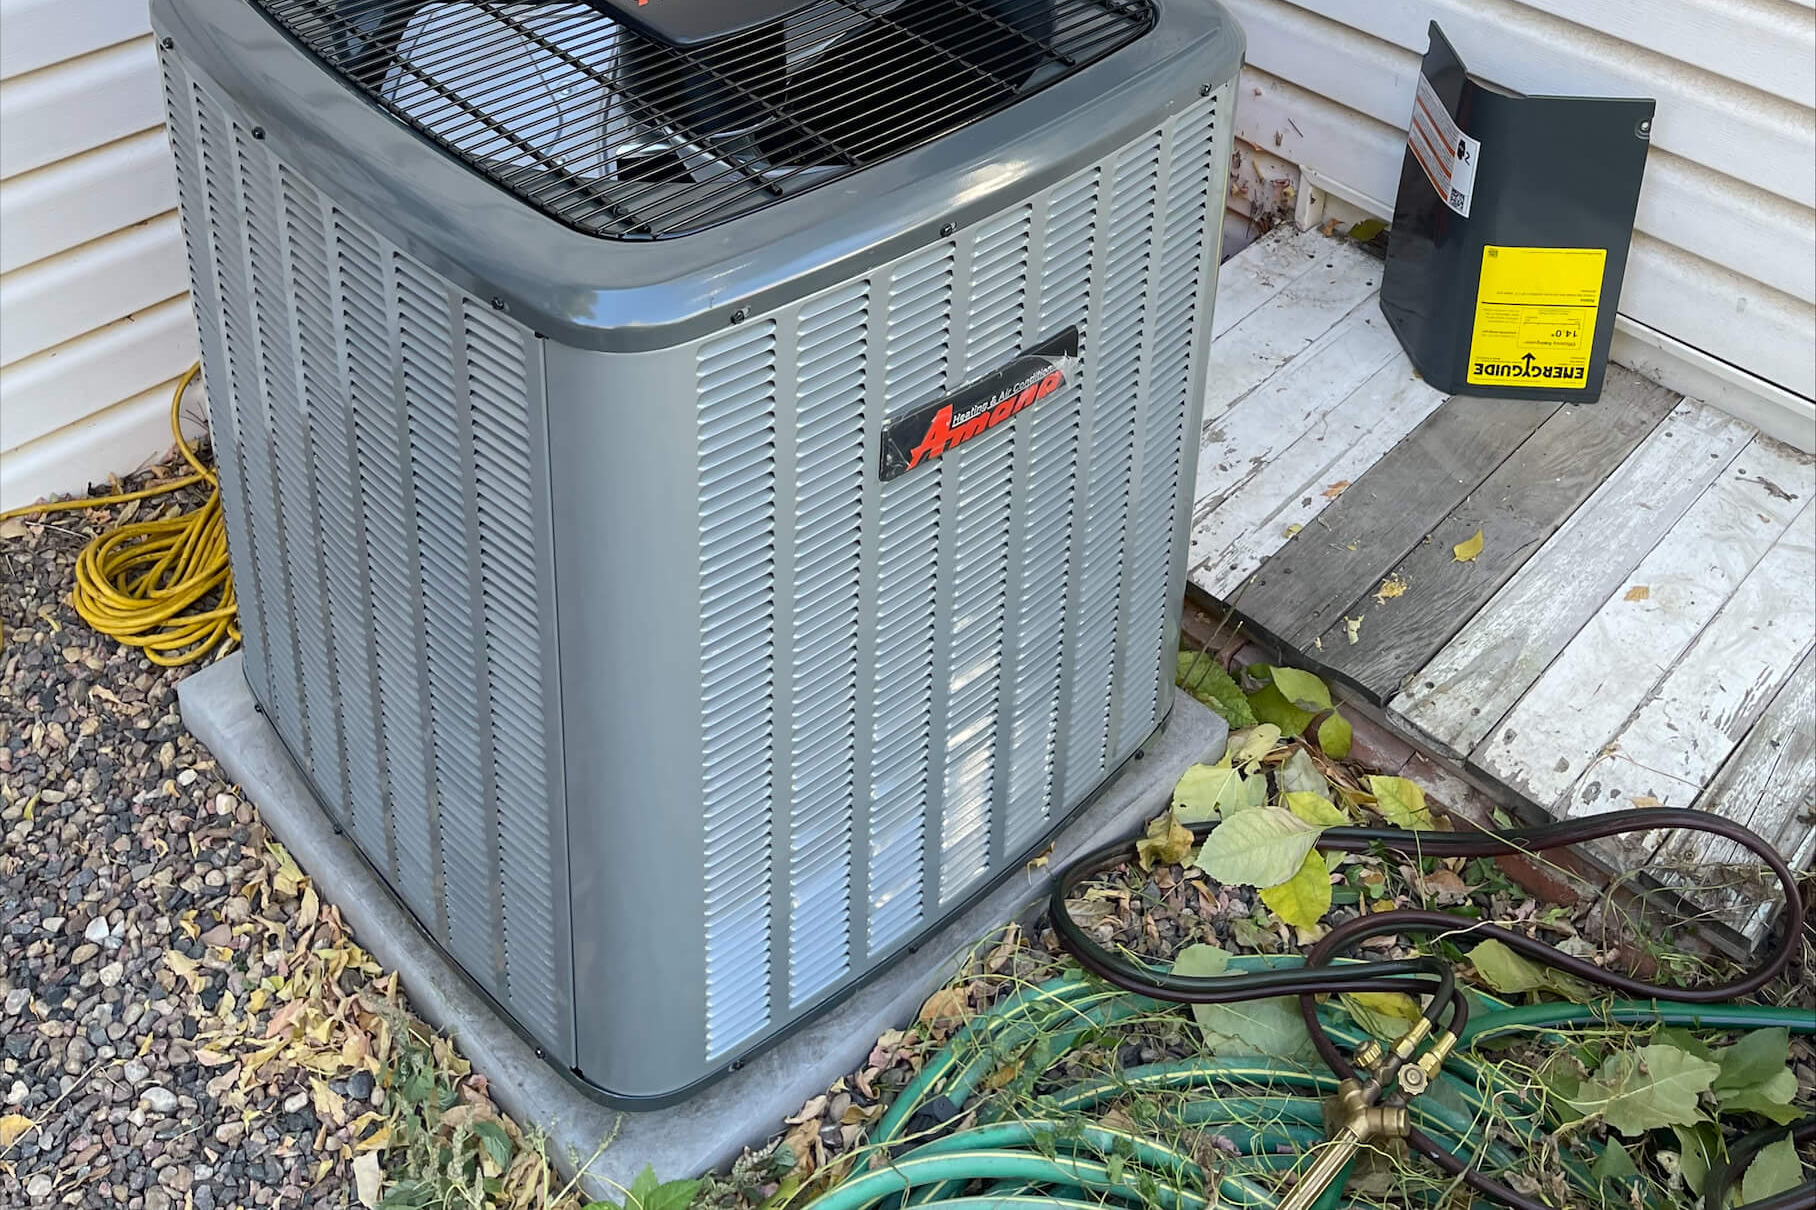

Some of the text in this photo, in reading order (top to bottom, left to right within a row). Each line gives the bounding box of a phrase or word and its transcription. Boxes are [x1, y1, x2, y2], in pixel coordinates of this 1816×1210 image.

[1473, 363, 1585, 379] ENERGYGUIDE
[904, 369, 1063, 472] Amana
[952, 401, 988, 425] Heating
[989, 395, 997, 406] &
[998, 388, 1011, 401] Air
